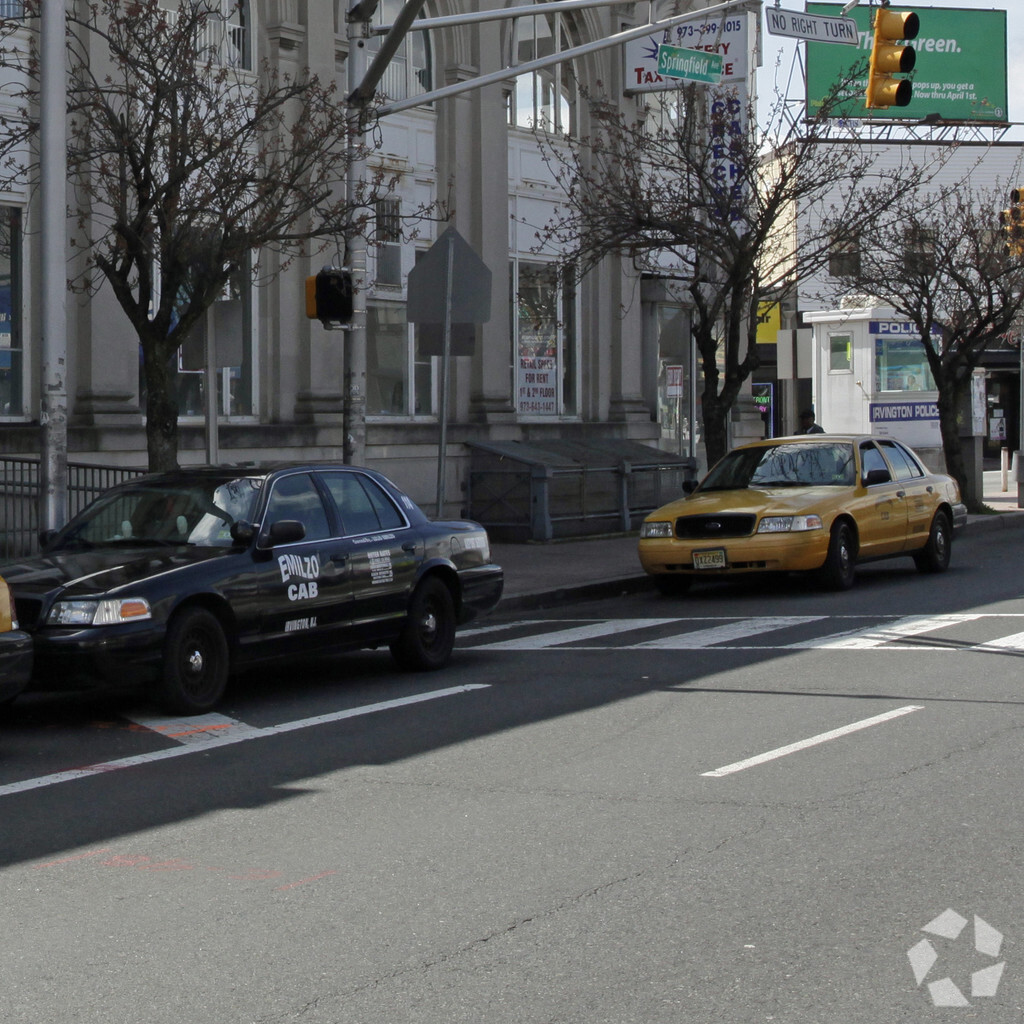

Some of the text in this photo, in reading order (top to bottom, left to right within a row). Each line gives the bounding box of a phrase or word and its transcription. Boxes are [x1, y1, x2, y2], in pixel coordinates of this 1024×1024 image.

[771, 14, 854, 38] NO RIGHT TURN
[661, 51, 708, 77] Springfield
[634, 67, 664, 85] TAX
[912, 82, 930, 90] pops
[942, 83, 956, 91] you
[957, 83, 968, 91] get
[931, 91, 946, 99] thru
[947, 91, 964, 100] April
[525, 373, 549, 384] FOR RENT
[540, 387, 555, 398] FLOOR
[873, 406, 912, 419] IRVINGTON
[278, 554, 320, 583] EMILZO
[287, 581, 319, 601] CAB
